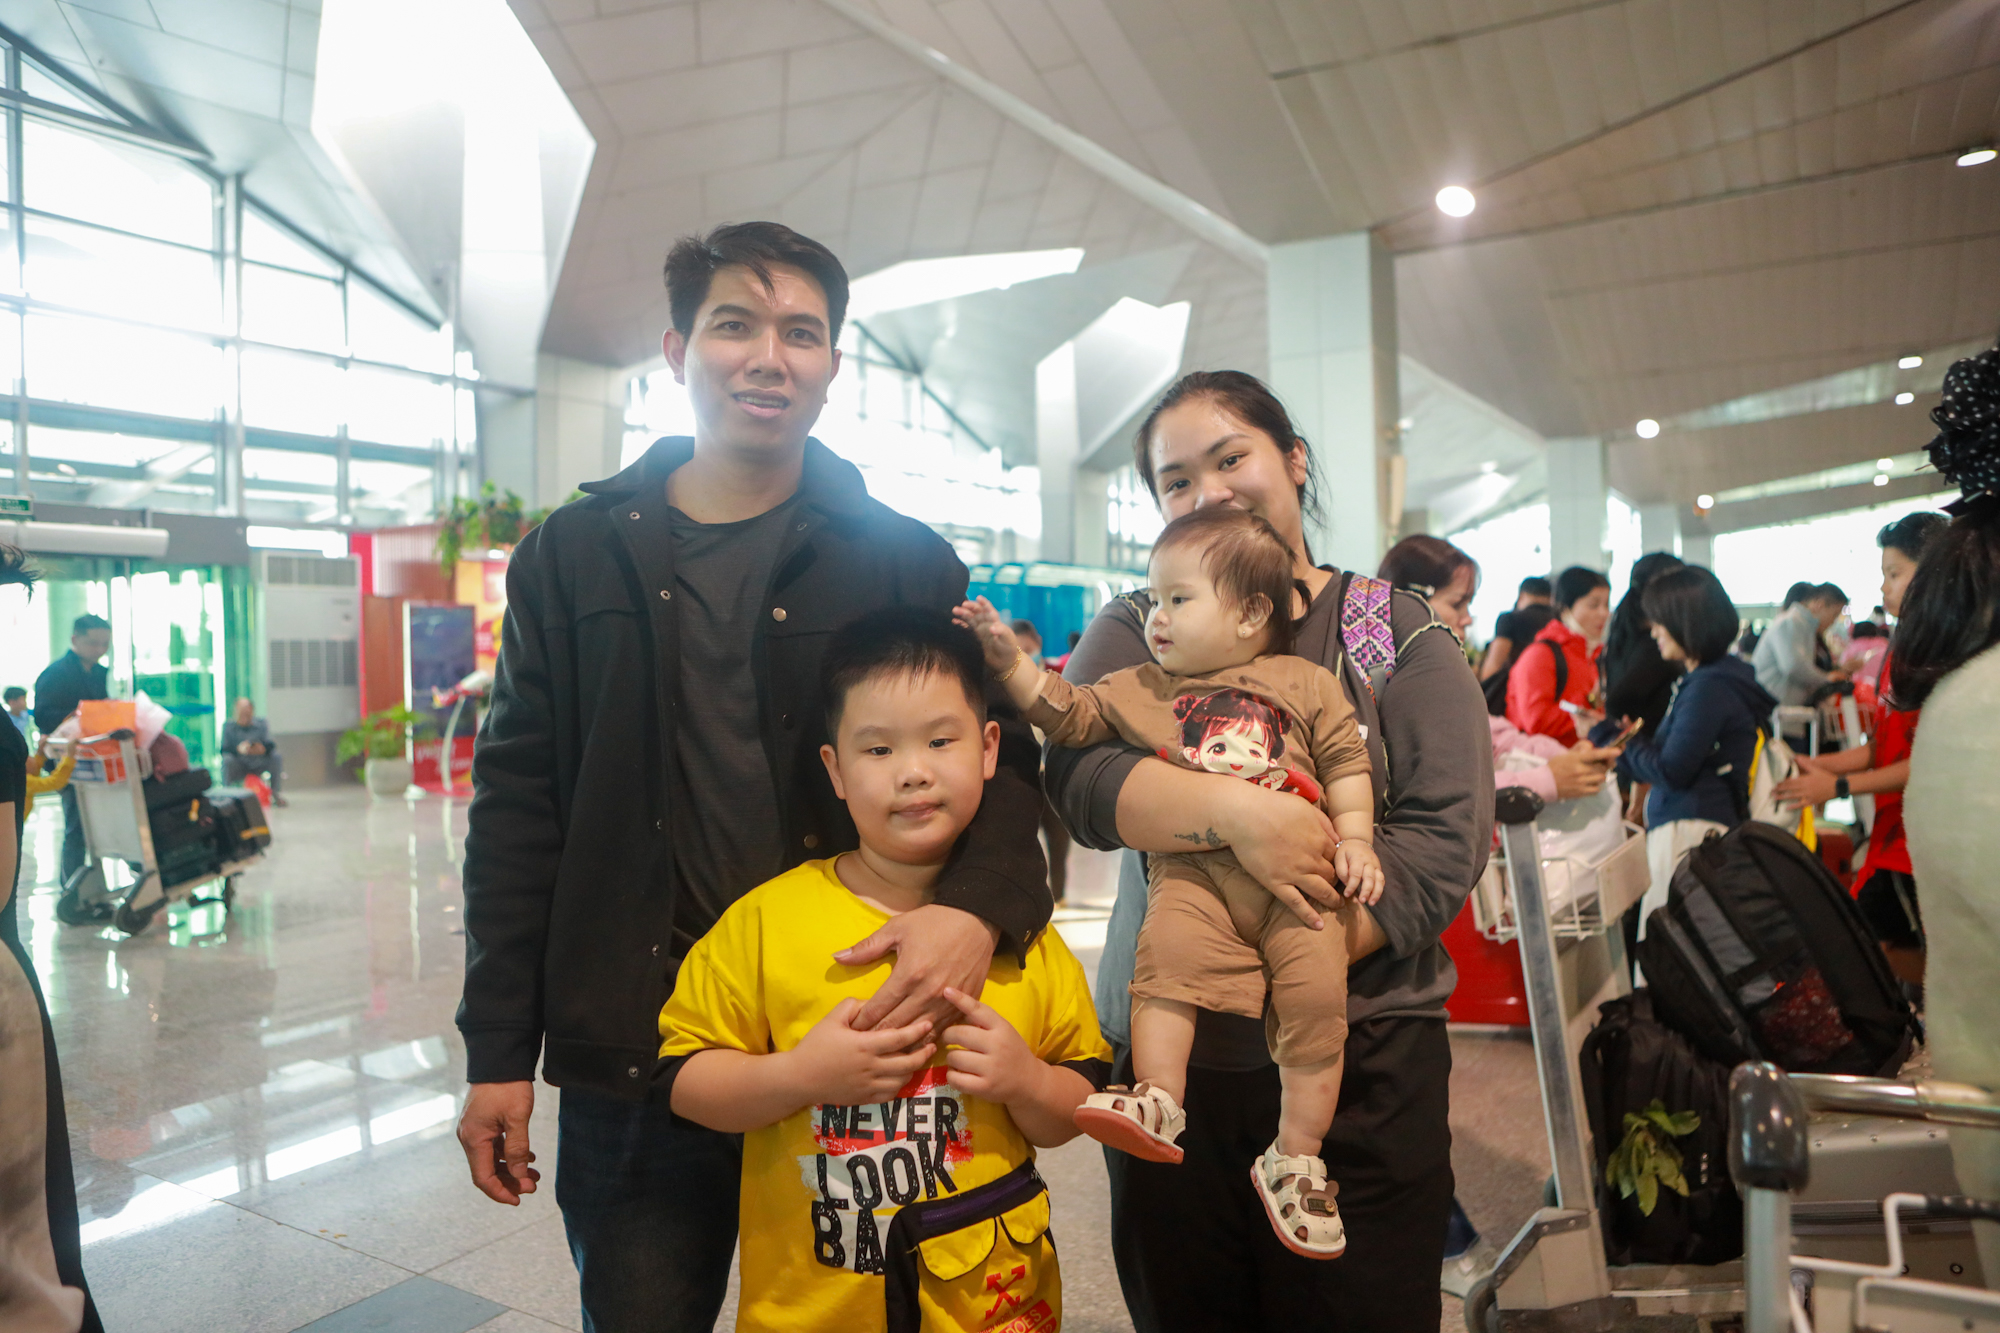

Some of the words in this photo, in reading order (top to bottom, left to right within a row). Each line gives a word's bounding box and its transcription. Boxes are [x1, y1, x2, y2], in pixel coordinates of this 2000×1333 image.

[821, 1096, 959, 1142] NEVER
[816, 1134, 958, 1210] LOOK
[811, 1200, 886, 1276] BA
